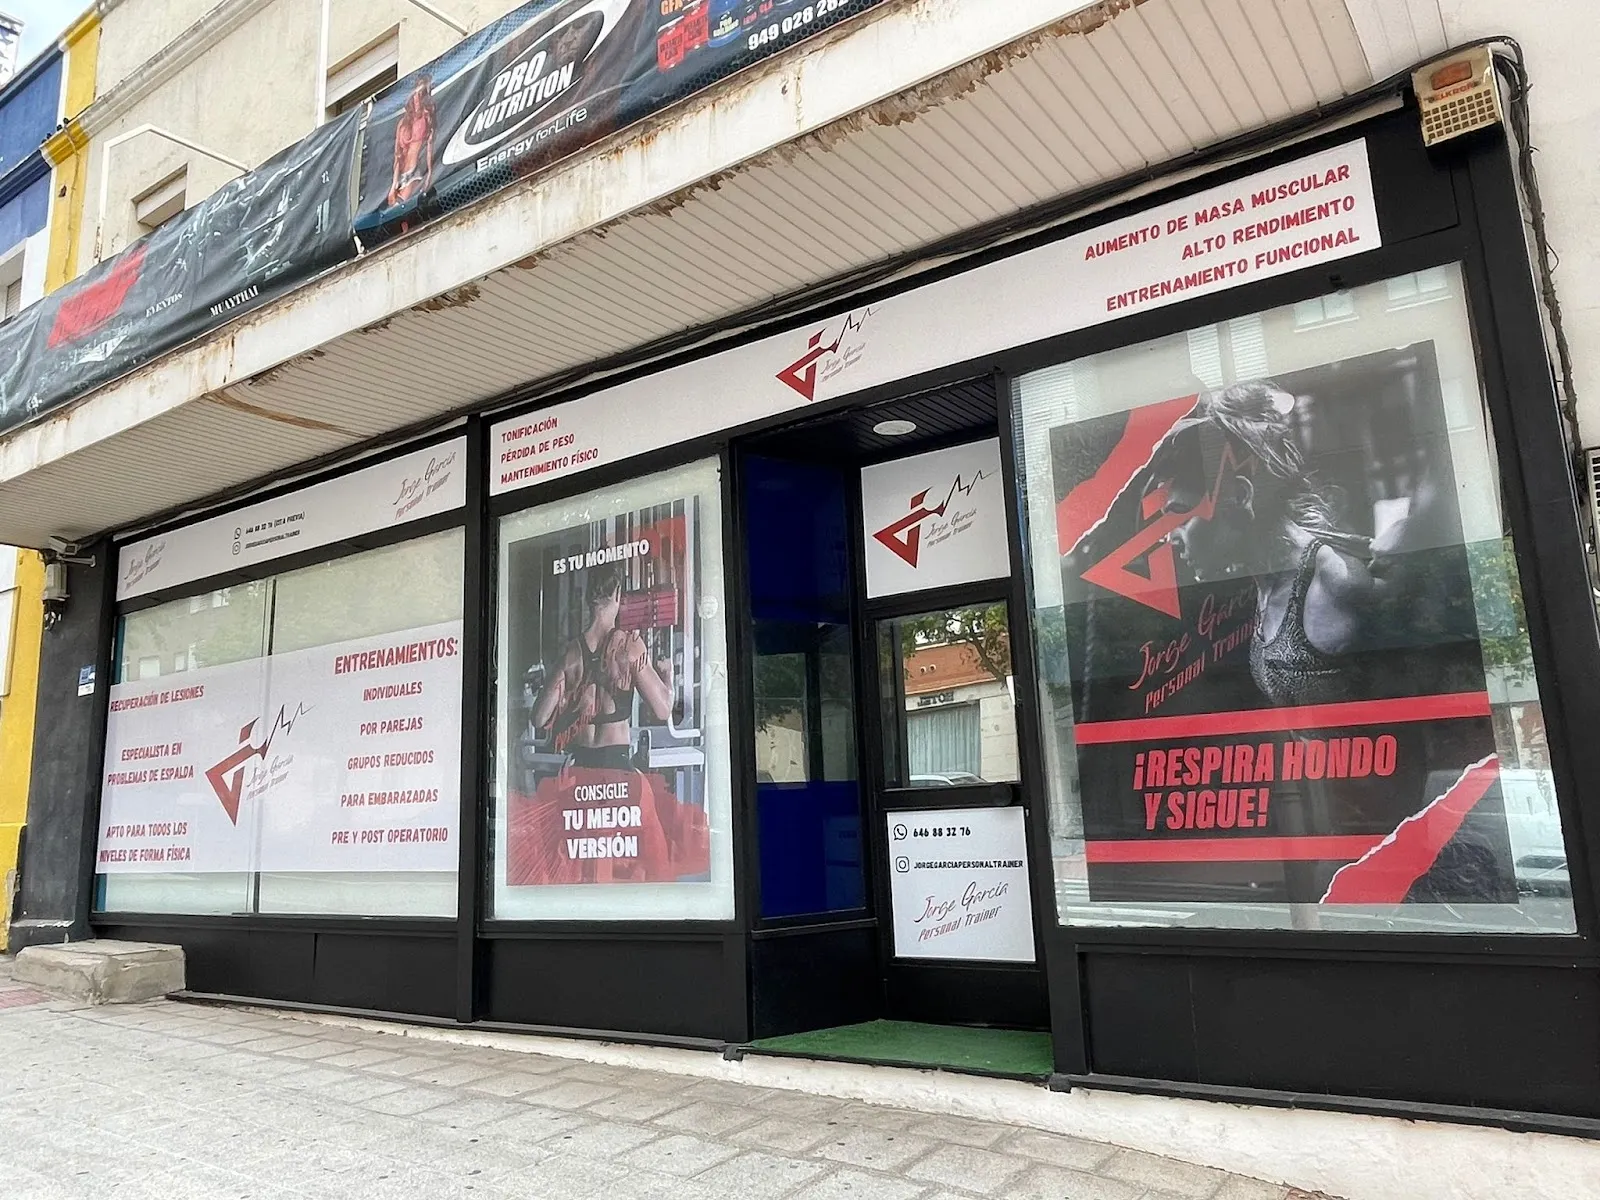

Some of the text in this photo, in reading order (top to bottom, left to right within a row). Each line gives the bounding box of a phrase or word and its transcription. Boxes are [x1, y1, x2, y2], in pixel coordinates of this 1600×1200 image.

[748, 23, 779, 51] 949
[781, 8, 813, 35] 028
[487, 51, 547, 107] PRO
[471, 61, 575, 137] NUTRITION
[476, 136, 534, 173] Energy
[1084, 164, 1350, 261] AUMENTO DE MASA MUSCULAR
[1181, 195, 1355, 261] ALTO RENDIMIENTO
[1106, 227, 1360, 312] ENTRENAMIENTO FUNCIONAL
[209, 285, 259, 318] MUAYTHAI
[501, 416, 558, 443] TONIFICACIÓN
[501, 433, 575, 464] PÉRDIDA DE PESO
[501, 448, 598, 484] MANTENIMIENTO FÍSICO
[552, 539, 649, 575] ES TU MOMENTO
[335, 637, 458, 675] ENTRENAMIENTOS:
[1129, 632, 1192, 690] Jorge
[363, 681, 423, 701] INDIVIDUALES
[1145, 651, 1205, 714] Personal
[109, 684, 205, 713] RECUPERACIÓN DE LESIONES
[360, 716, 423, 735] POR PAREJAS
[121, 742, 182, 762] ESPECIALISTA EN
[347, 750, 434, 770] GRUPOS REDUCIDOS
[1133, 734, 1398, 790] ¡RESPIRA HONDO
[107, 765, 194, 785] PROBLEMAS DE ESPALDA
[341, 788, 439, 807] PARA EMBARAZADAS
[574, 782, 629, 802] CONSIGUE
[562, 805, 642, 830] TU MEJOR
[1144, 787, 1270, 831] Y SIGUE!
[106, 821, 188, 839] APTO PARA TODOS LOS
[331, 827, 448, 845] PRE Y POST OPERATORIO
[913, 827, 971, 837] 646 88 32 76
[99, 844, 191, 863] NIVELES DE FORMA FÍSICA
[566, 832, 638, 859] VERSIÓN
[914, 860, 1024, 869] JORGEGARCIAPERSONALTRAINER
[914, 895, 957, 923] Jorge
[918, 905, 1002, 942] Personal Trainer
